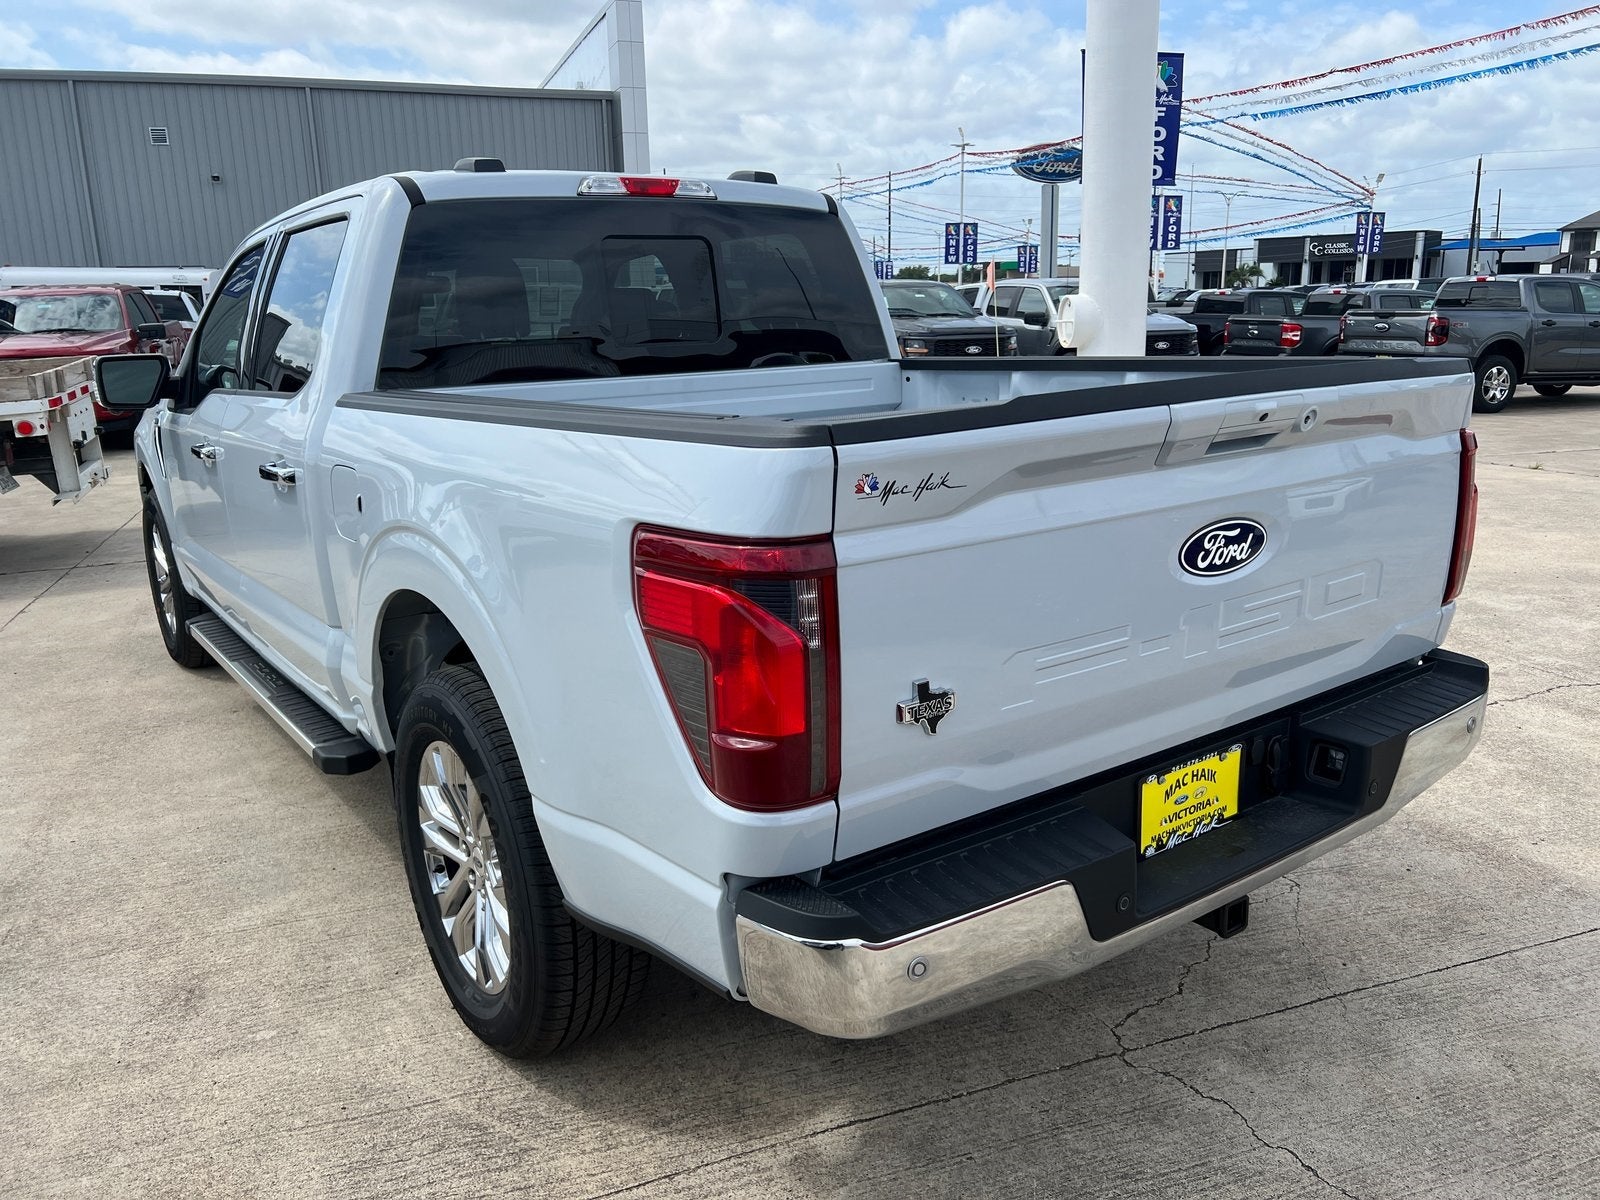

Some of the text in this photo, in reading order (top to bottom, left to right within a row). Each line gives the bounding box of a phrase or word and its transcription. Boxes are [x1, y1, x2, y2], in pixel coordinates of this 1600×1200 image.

[1033, 150, 1081, 174] Ford
[1167, 217, 1177, 248] FORD
[1356, 228, 1365, 252] NEW
[1372, 228, 1381, 252] FORD
[947, 239, 956, 263] NEW
[879, 472, 967, 506] Mac Haik
[1197, 527, 1253, 568] Ford
[1001, 559, 1383, 711] F-150
[906, 696, 953, 721] TEXAS
[1163, 768, 1217, 804] MAC HAIK
[1167, 799, 1212, 823] VICTORIA
[1166, 816, 1233, 850] Mac Haik
